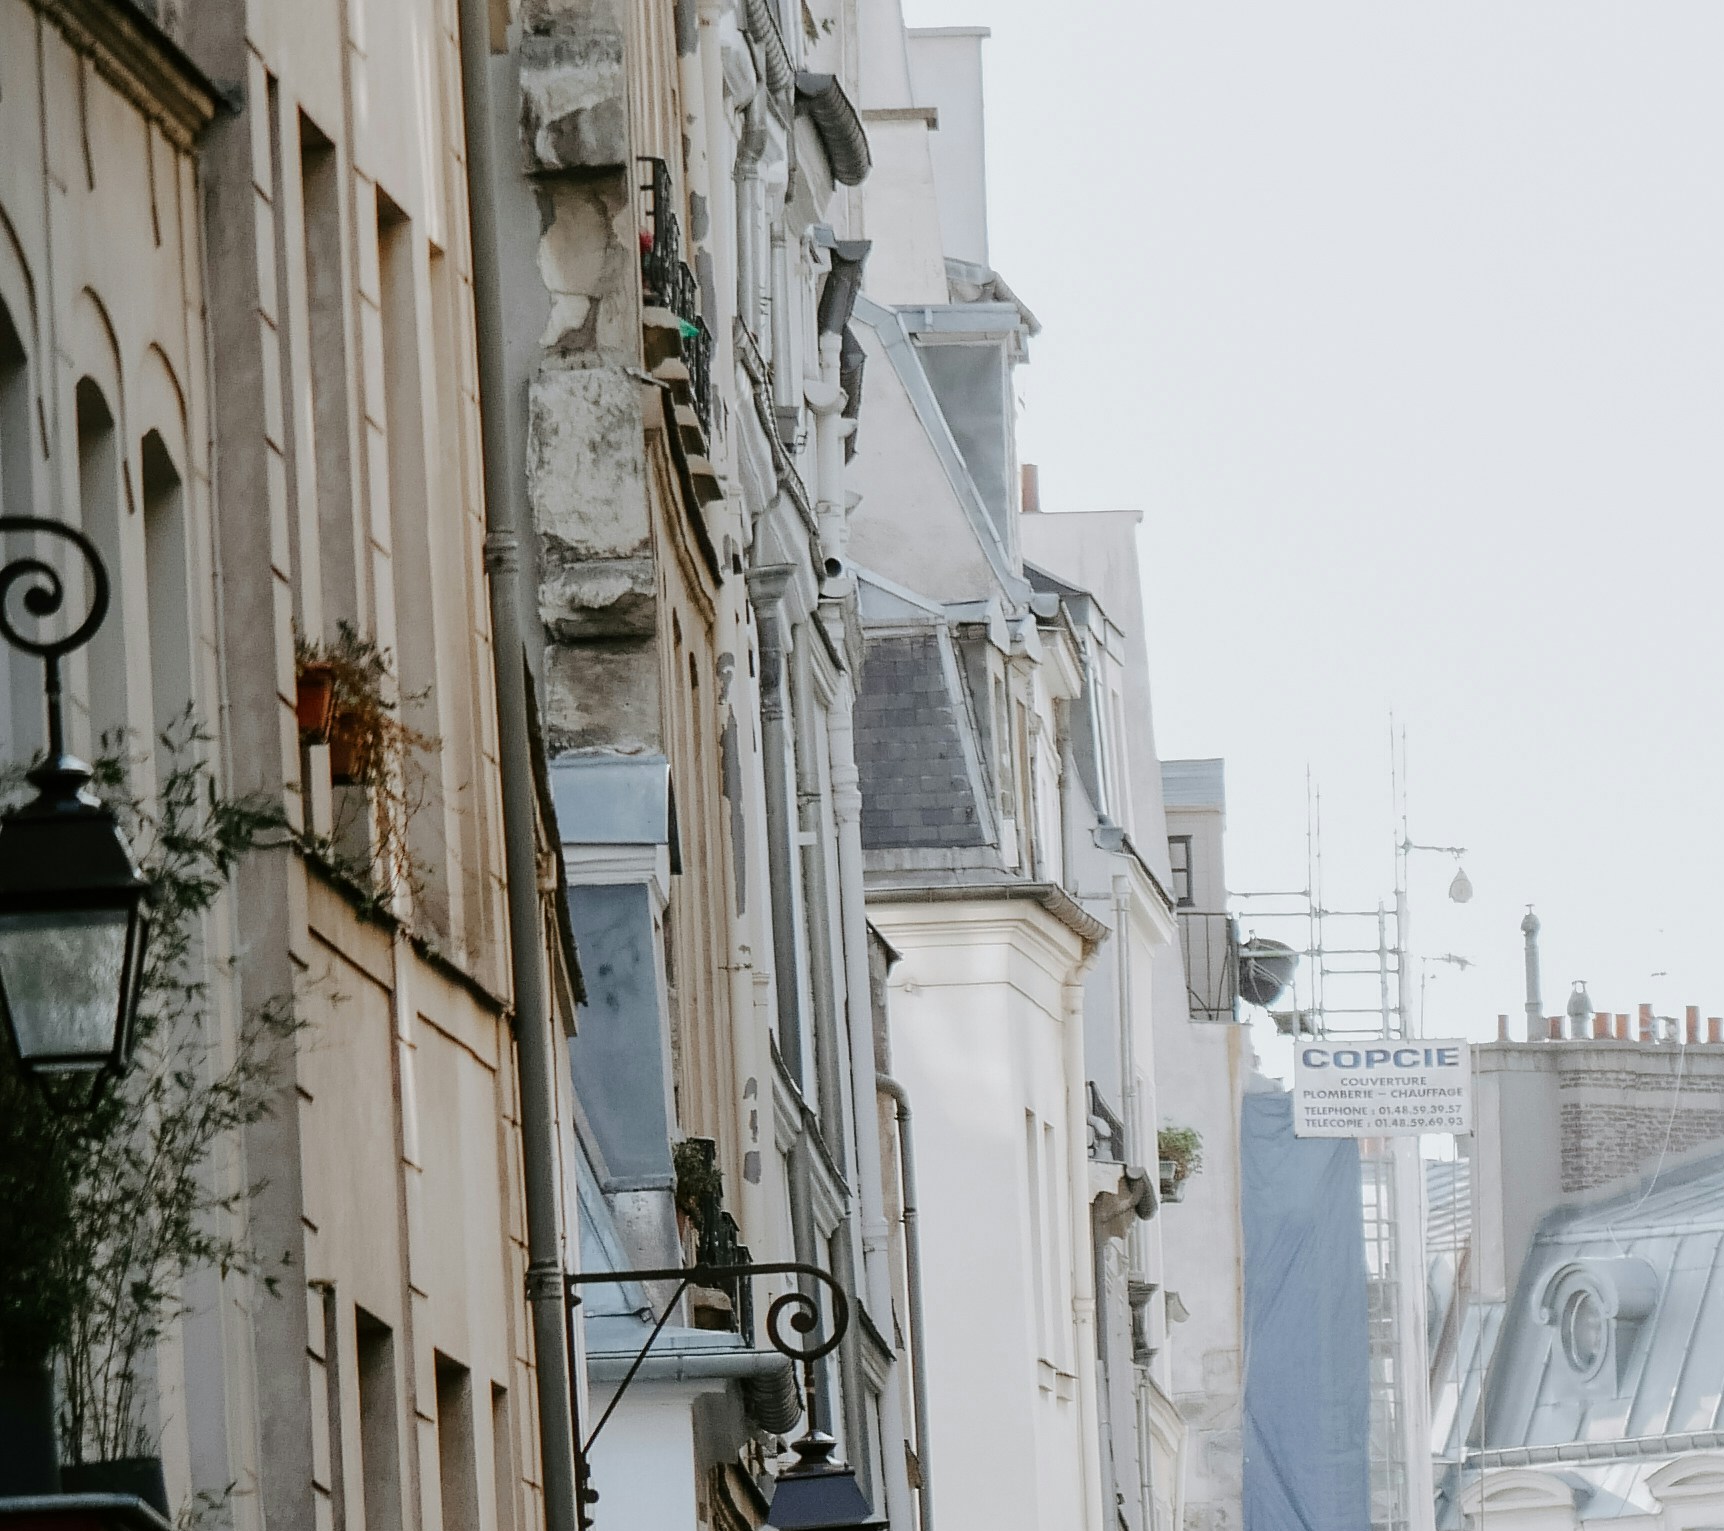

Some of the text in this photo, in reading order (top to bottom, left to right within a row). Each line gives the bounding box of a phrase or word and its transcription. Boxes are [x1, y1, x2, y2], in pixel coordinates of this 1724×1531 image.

[1302, 1047, 1459, 1069] COPCIE
[1340, 1077, 1427, 1086] COUVERTURE
[1303, 1087, 1463, 1099] PLOMBERIE CHAUFFAGE
